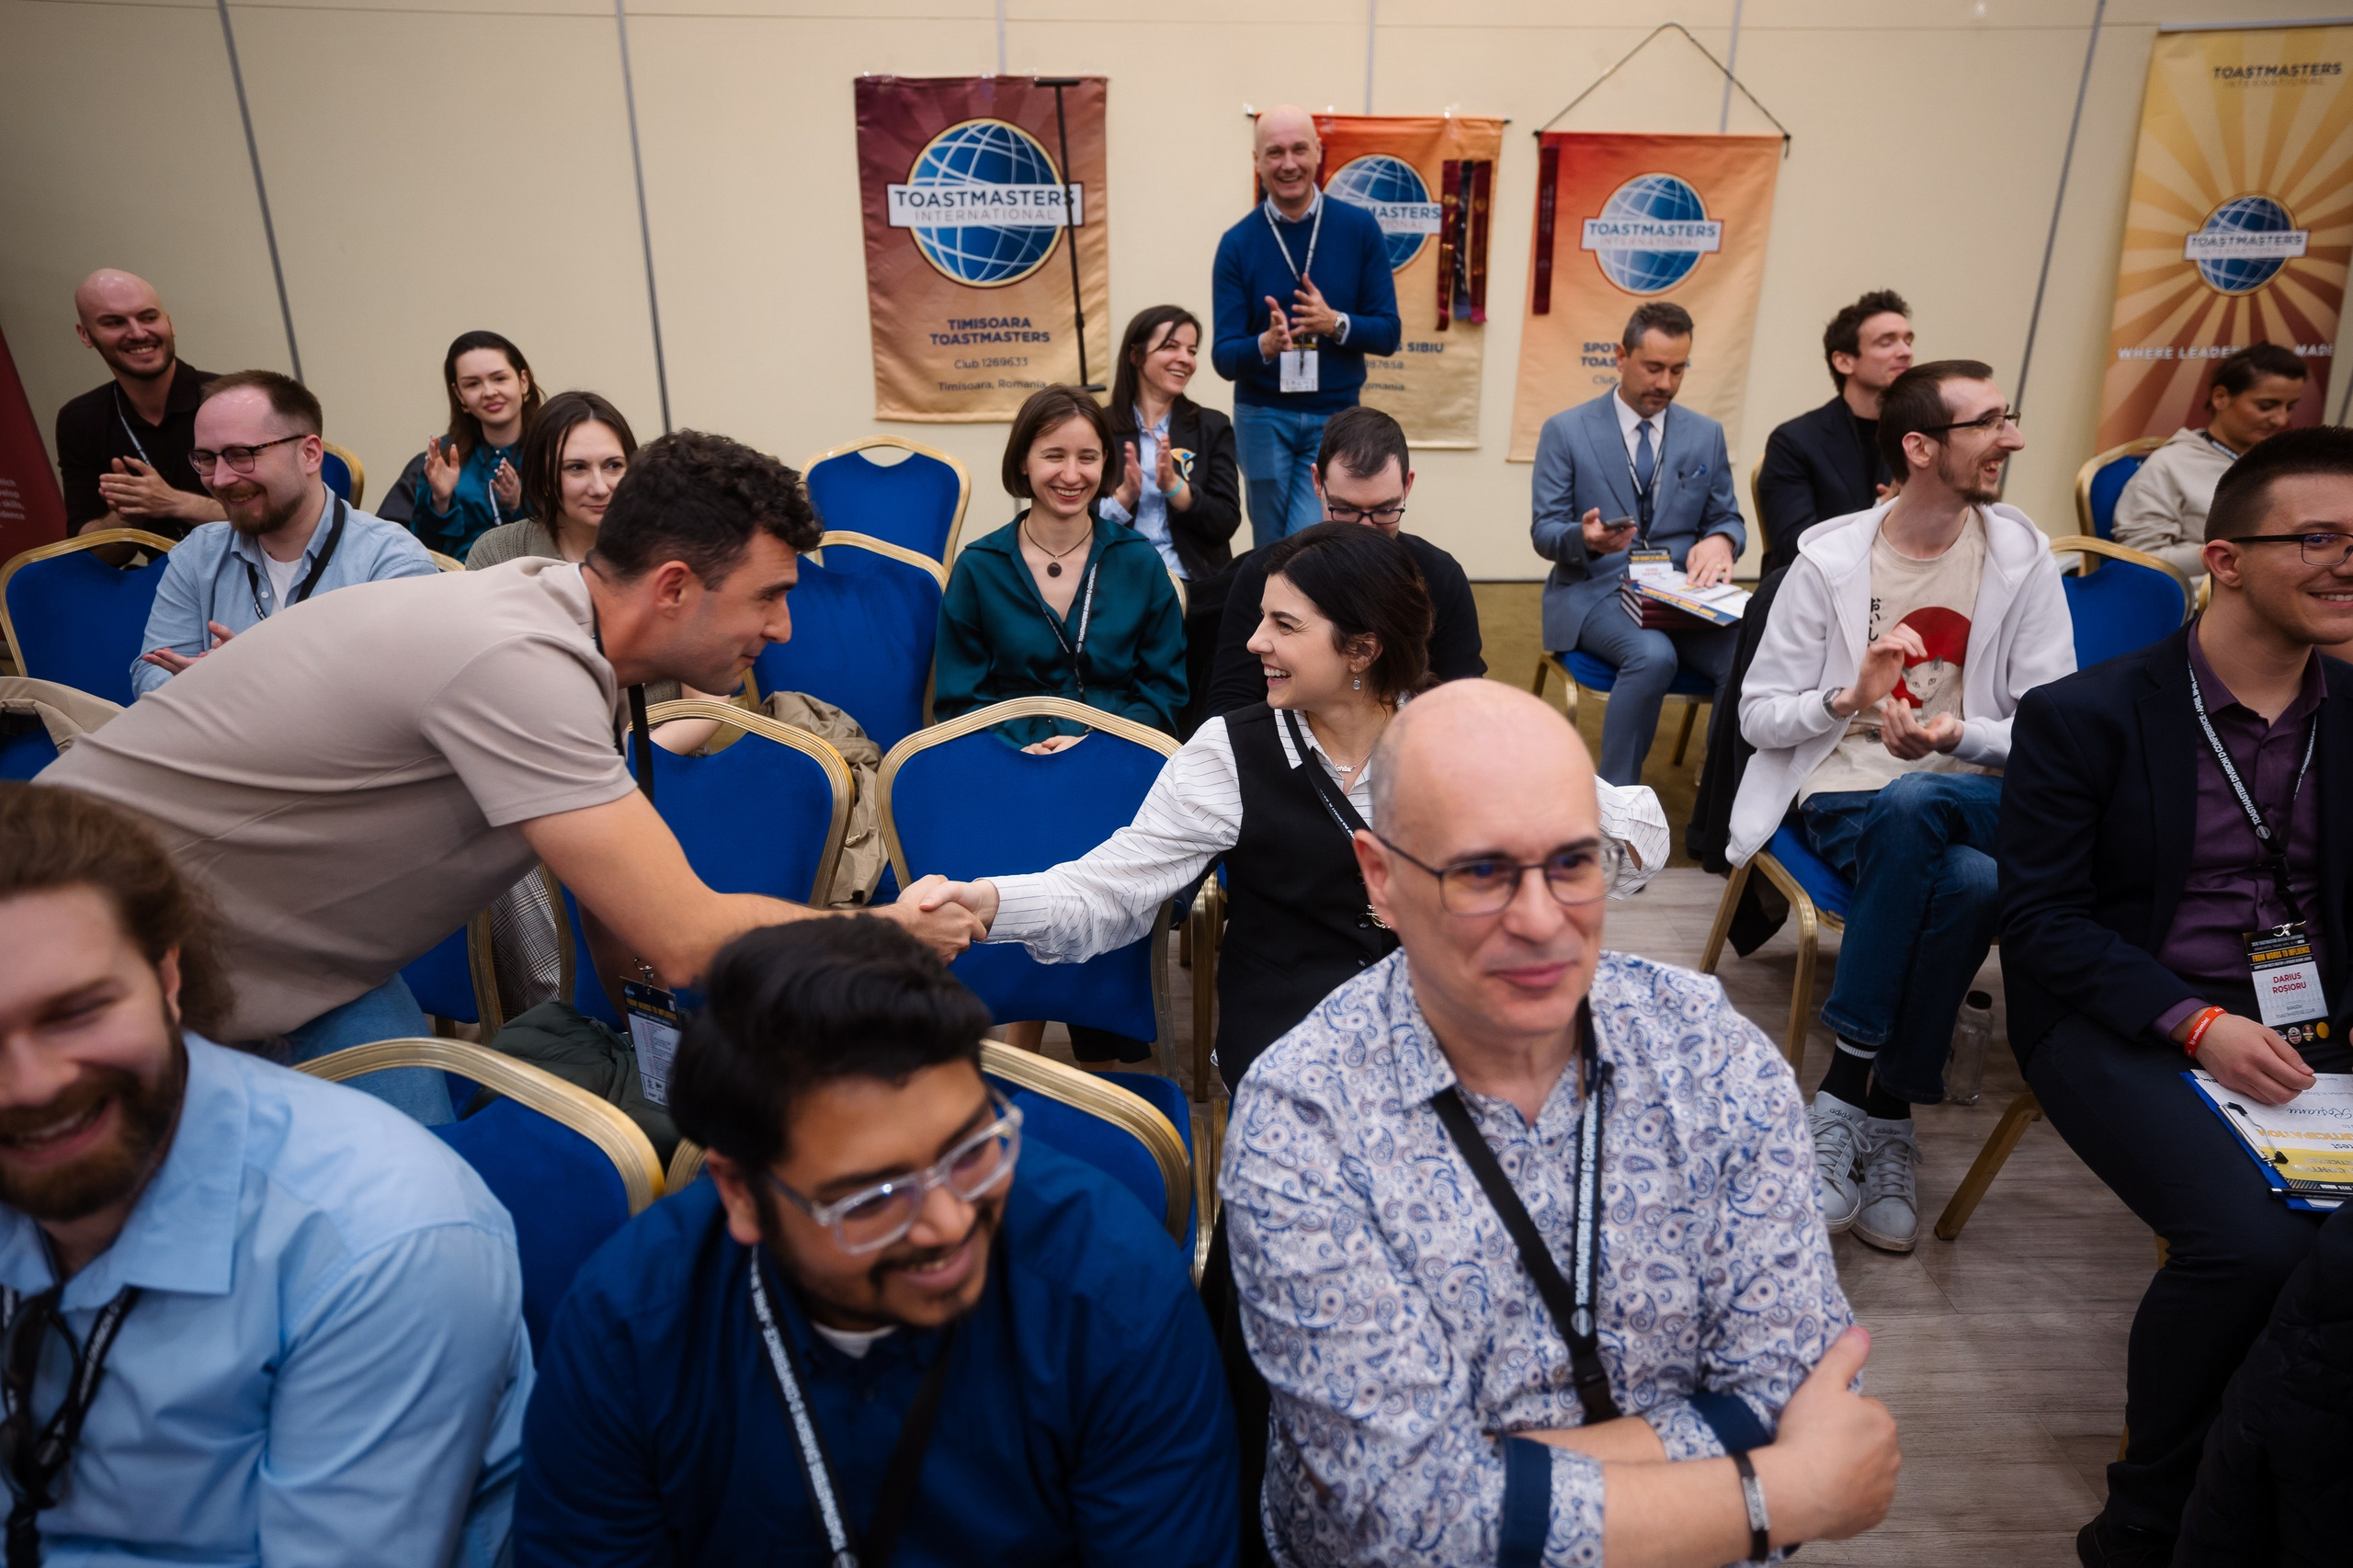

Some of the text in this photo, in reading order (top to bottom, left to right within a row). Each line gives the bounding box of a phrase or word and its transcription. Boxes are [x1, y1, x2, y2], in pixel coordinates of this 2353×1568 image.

[2213, 62, 2341, 79] TOASTMASTERS
[894, 189, 1074, 208] TOASTMASTERS
[915, 208, 1056, 222] INTERNATIONAL
[1367, 206, 1440, 219] MASTERS
[1588, 222, 1716, 237] TOASTMASTERS
[2190, 235, 2302, 247] TOASTMASTERS
[947, 317, 1032, 331] TIMISOARA
[929, 331, 1051, 345] TOASTMASTERS
[1407, 342, 1444, 353] SIBIU
[2118, 347, 2174, 360] WHERE
[954, 359, 979, 369] Club
[938, 378, 1047, 392] Timisoara, Romania
[2199, 714, 2222, 753] CONFERENCE
[2218, 751, 2226, 759] D
[2219, 755, 2240, 783] DIVISION
[2232, 779, 2262, 826] TOASTMASTERS
[2252, 954, 2267, 962] FROM
[2266, 951, 2283, 960] WORDS
[2282, 949, 2290, 958] TO
[2288, 946, 2311, 957] INFLUENCE
[2272, 972, 2302, 984] DARIUS
[1578, 1172, 1594, 1221] DIVISION
[1574, 1221, 1592, 1306] TOASTMASTERS
